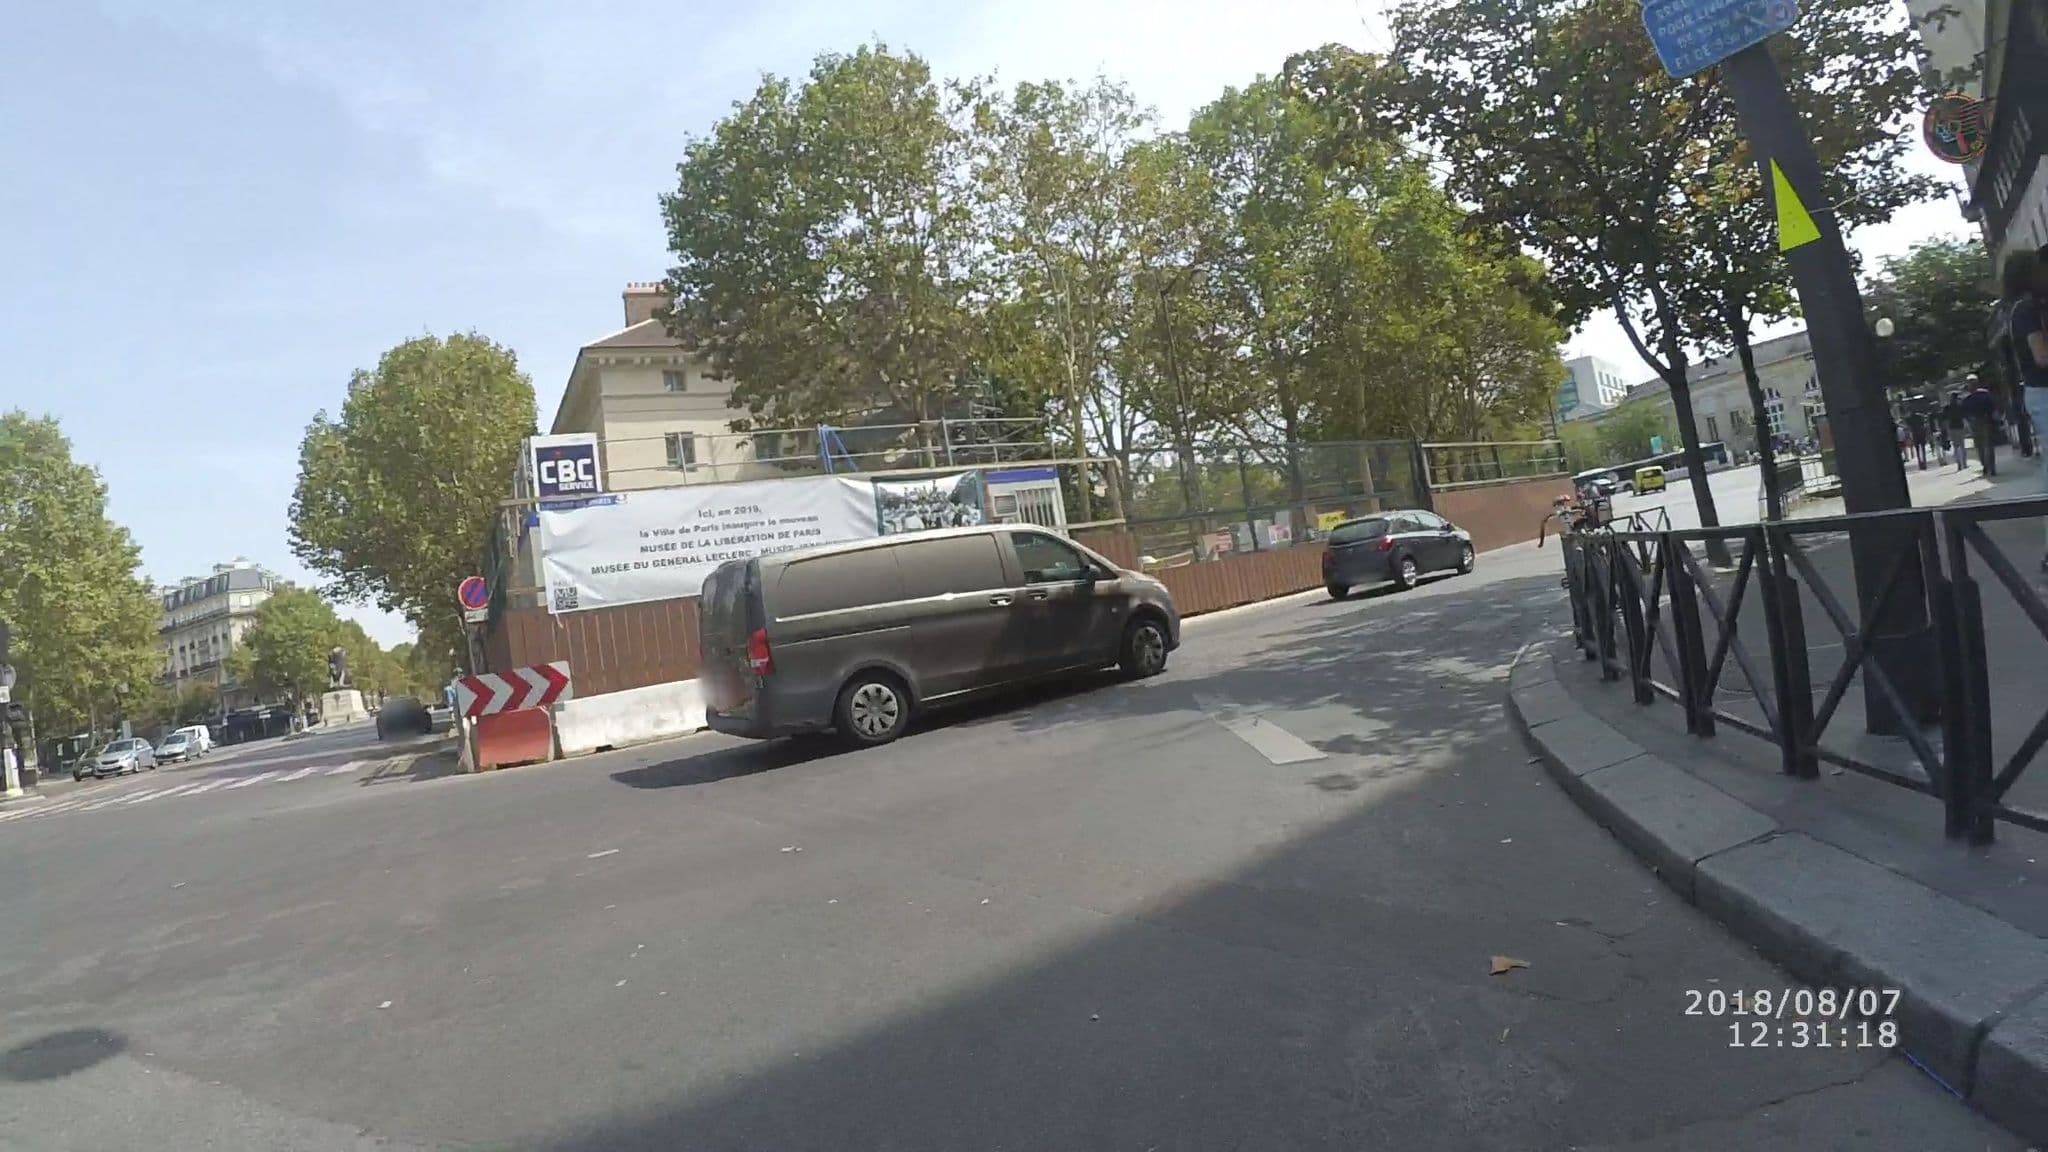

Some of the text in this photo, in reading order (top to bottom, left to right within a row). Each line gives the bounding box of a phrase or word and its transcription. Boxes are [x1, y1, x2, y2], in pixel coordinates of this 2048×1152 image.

[540, 458, 594, 484] CBC
[558, 480, 595, 491] SERVICE
[640, 515, 819, 538] la Ville de Paris inaugure le nouveau
[681, 540, 695, 549] DE
[698, 538, 711, 548] LA
[778, 530, 791, 540] DE
[794, 527, 821, 539] PARIS
[634, 560, 649, 570] DU
[705, 549, 752, 562] LECLERC
